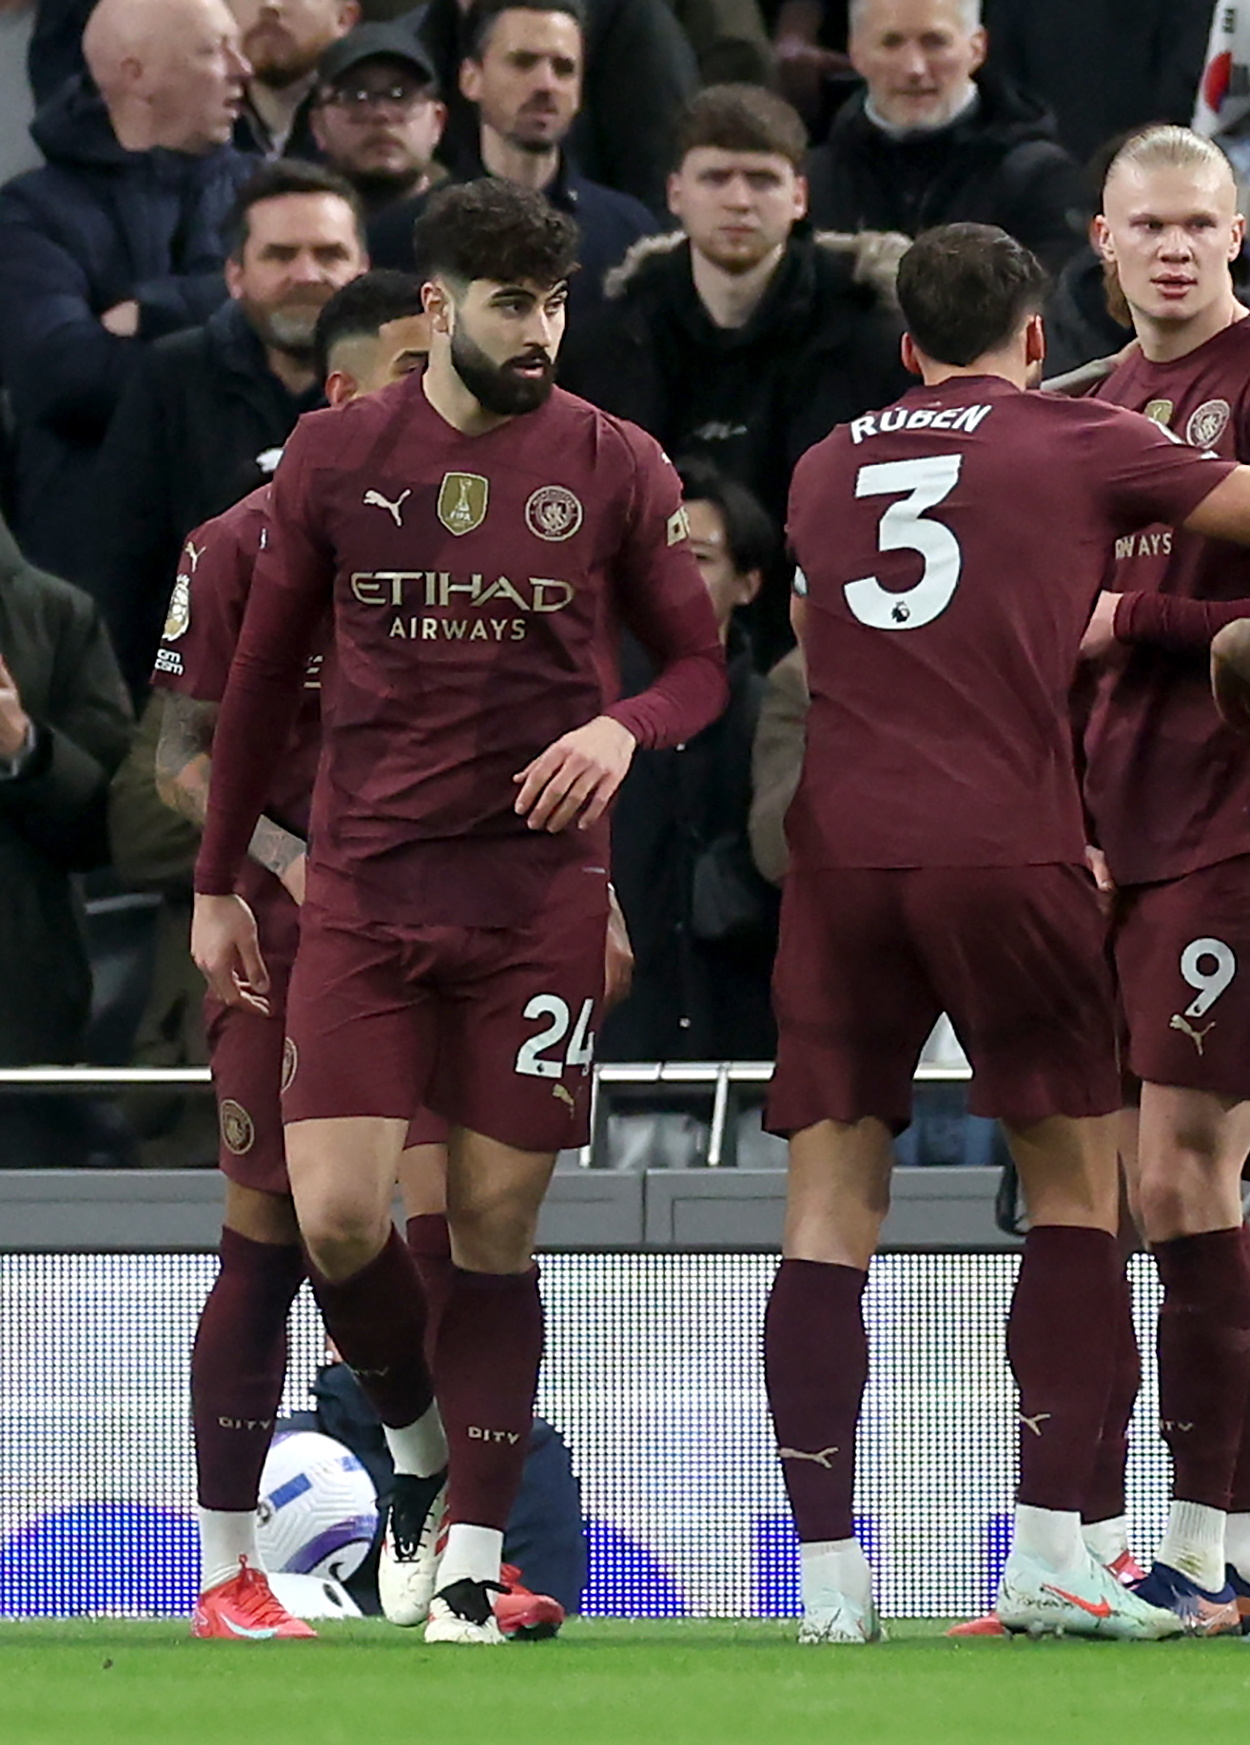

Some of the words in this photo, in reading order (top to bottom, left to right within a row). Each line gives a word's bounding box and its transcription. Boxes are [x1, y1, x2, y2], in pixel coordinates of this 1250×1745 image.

[843, 453, 963, 631] 3
[350, 571, 575, 613] ETIHAD
[389, 616, 527, 641] AIRWAYS
[1181, 937, 1236, 1017] 9
[515, 993, 595, 1078] 24
